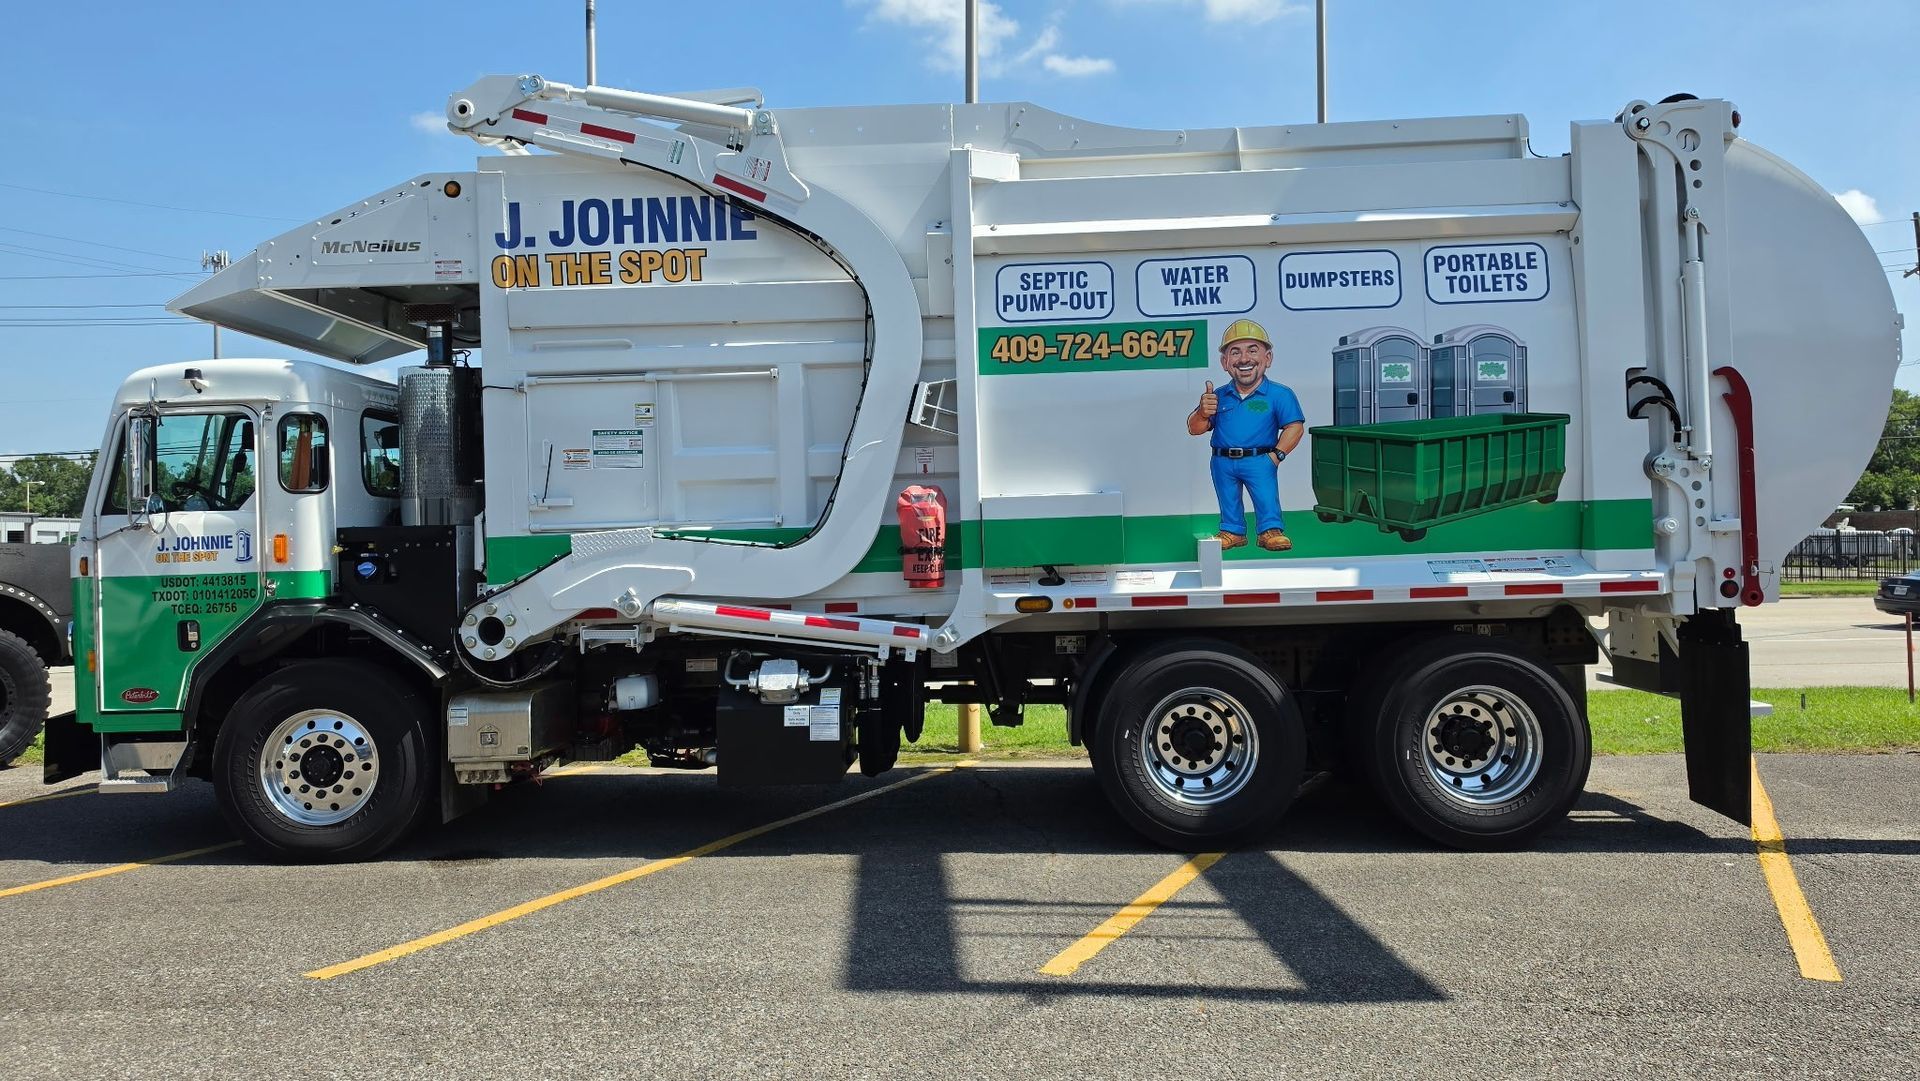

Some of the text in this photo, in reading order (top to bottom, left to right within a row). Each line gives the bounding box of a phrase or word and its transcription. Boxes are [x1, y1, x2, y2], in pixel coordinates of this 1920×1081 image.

[494, 194, 758, 250] J. JOHNNIE
[321, 239, 422, 255] McNeilus
[491, 253, 541, 289] ON
[545, 251, 613, 287] THE
[618, 248, 708, 285] SPOT
[1433, 251, 1538, 273] PORTABLE
[1019, 270, 1089, 291] SEPTIC
[1160, 264, 1230, 286] WATER
[1285, 269, 1395, 290] DUMPSTERS
[1445, 273, 1529, 295] TOILETS
[1002, 291, 1108, 313] PUMP-OUT
[1170, 286, 1222, 307] TANK
[991, 328, 1195, 363] 409-724-6647
[157, 535, 233, 552] J. JOHNNIE
[918, 527, 941, 543] FIRE
[155, 551, 219, 563] ON THE SPOT
[912, 564, 929, 573] KEEP
[161, 575, 247, 588] USDOT: 4413815
[152, 588, 257, 602] TXDOT: 010141205C
[171, 602, 238, 615] TCEQ: 26756
